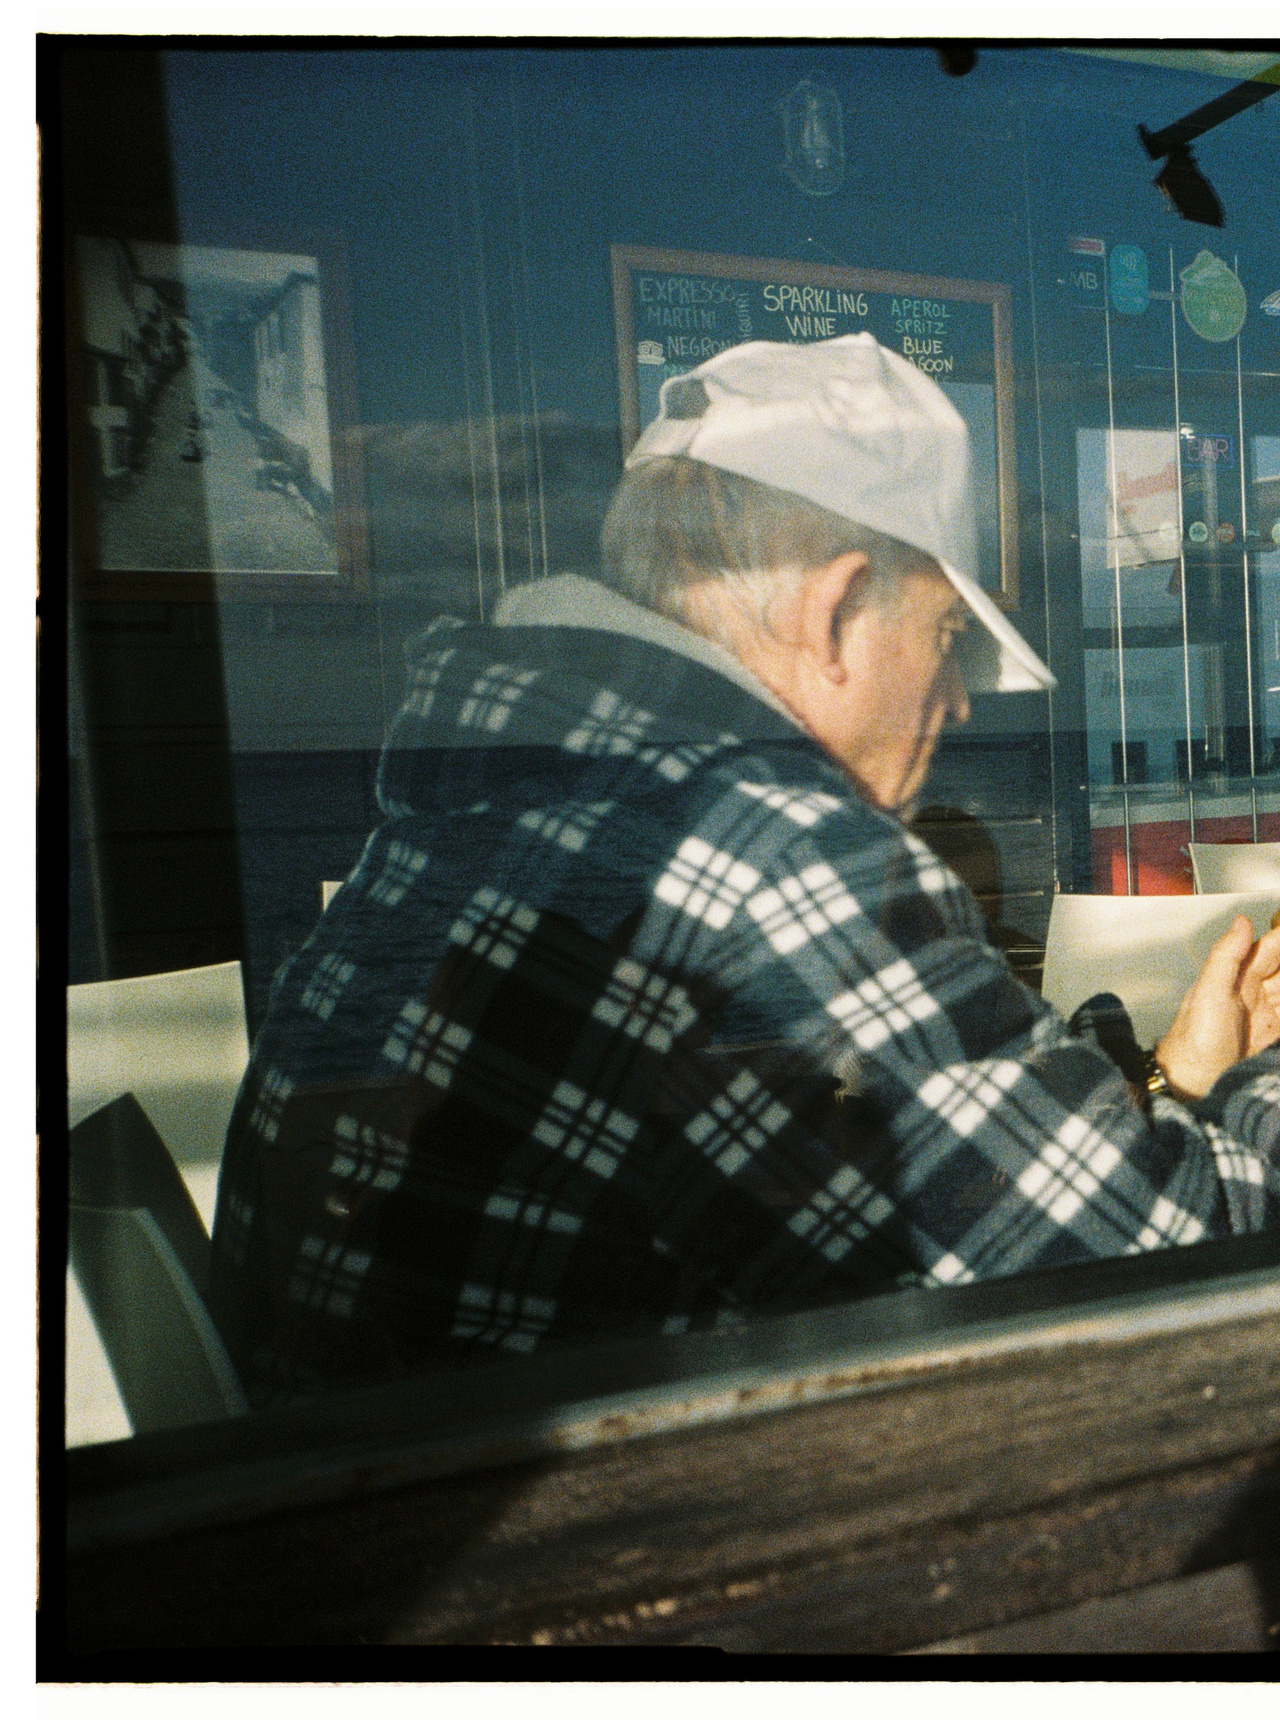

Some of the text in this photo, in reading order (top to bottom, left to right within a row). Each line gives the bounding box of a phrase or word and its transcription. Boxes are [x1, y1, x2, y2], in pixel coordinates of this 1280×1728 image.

[890, 297, 952, 319] APEROL
[902, 336, 943, 355] BLUE
[909, 355, 953, 372] AGOON
[1186, 438, 1230, 463] BAR
